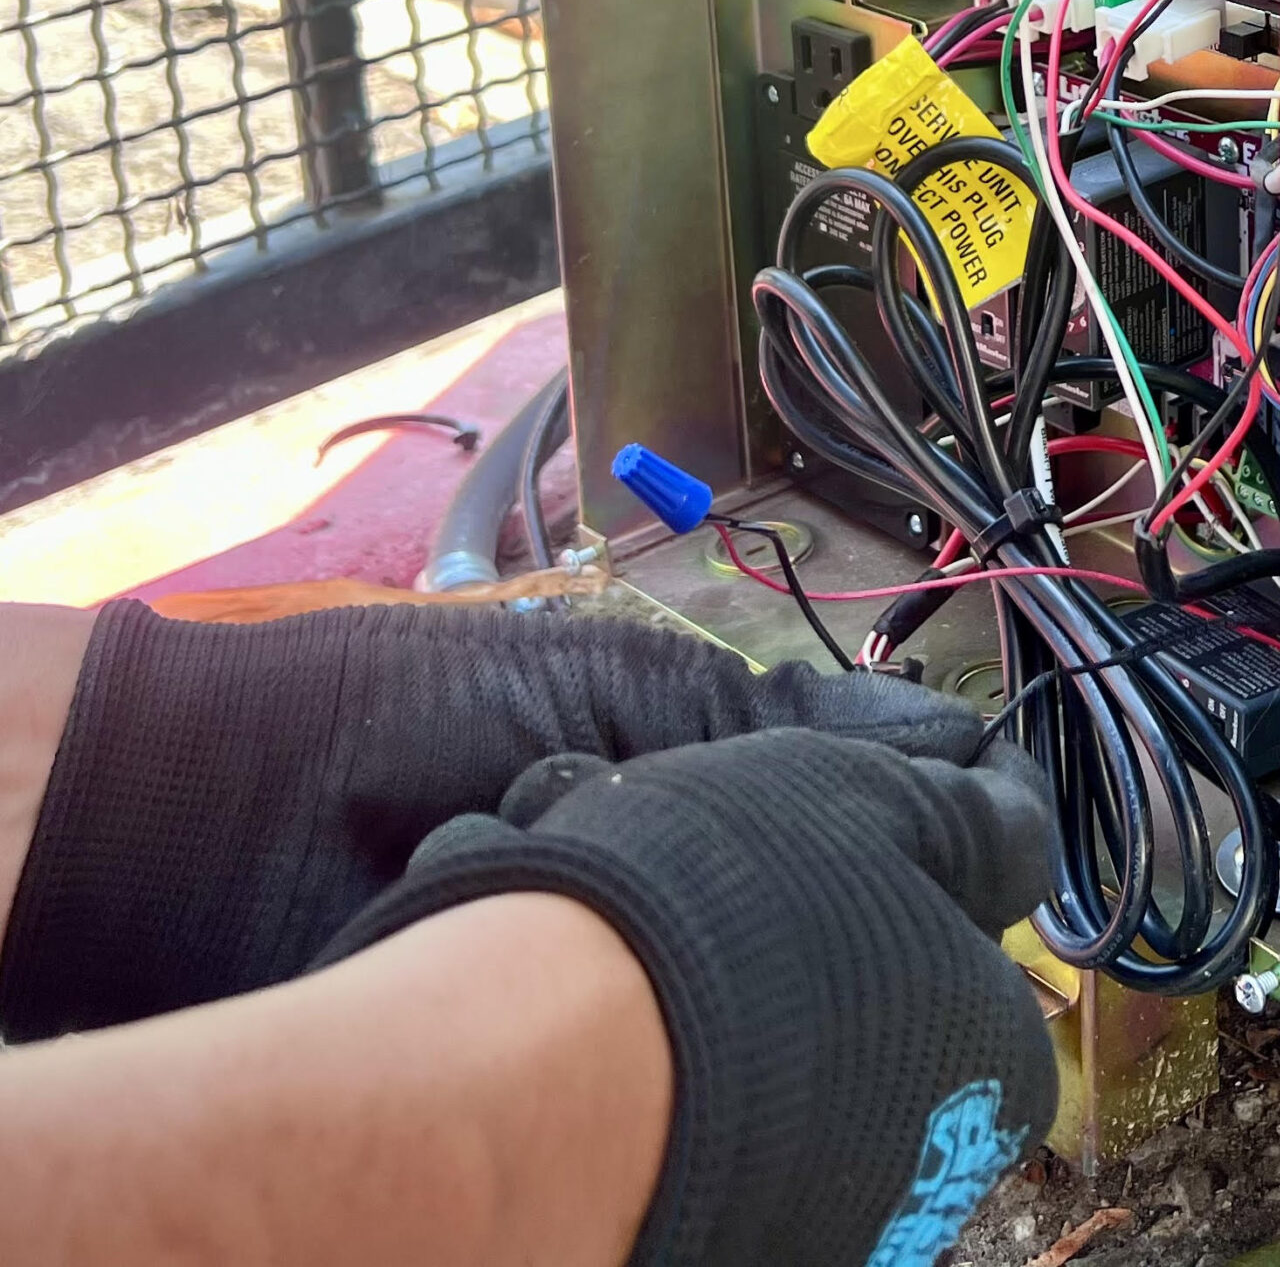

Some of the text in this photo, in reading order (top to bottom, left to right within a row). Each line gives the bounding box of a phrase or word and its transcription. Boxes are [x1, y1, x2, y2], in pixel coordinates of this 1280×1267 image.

[978, 167, 1022, 223] UNIT,
[962, 191, 1005, 249] PLUG
[941, 209, 989, 288] POWER
[1079, 316, 1087, 328] 6
[1206, 697, 1216, 712] ON
[1218, 701, 1228, 720] OFF
